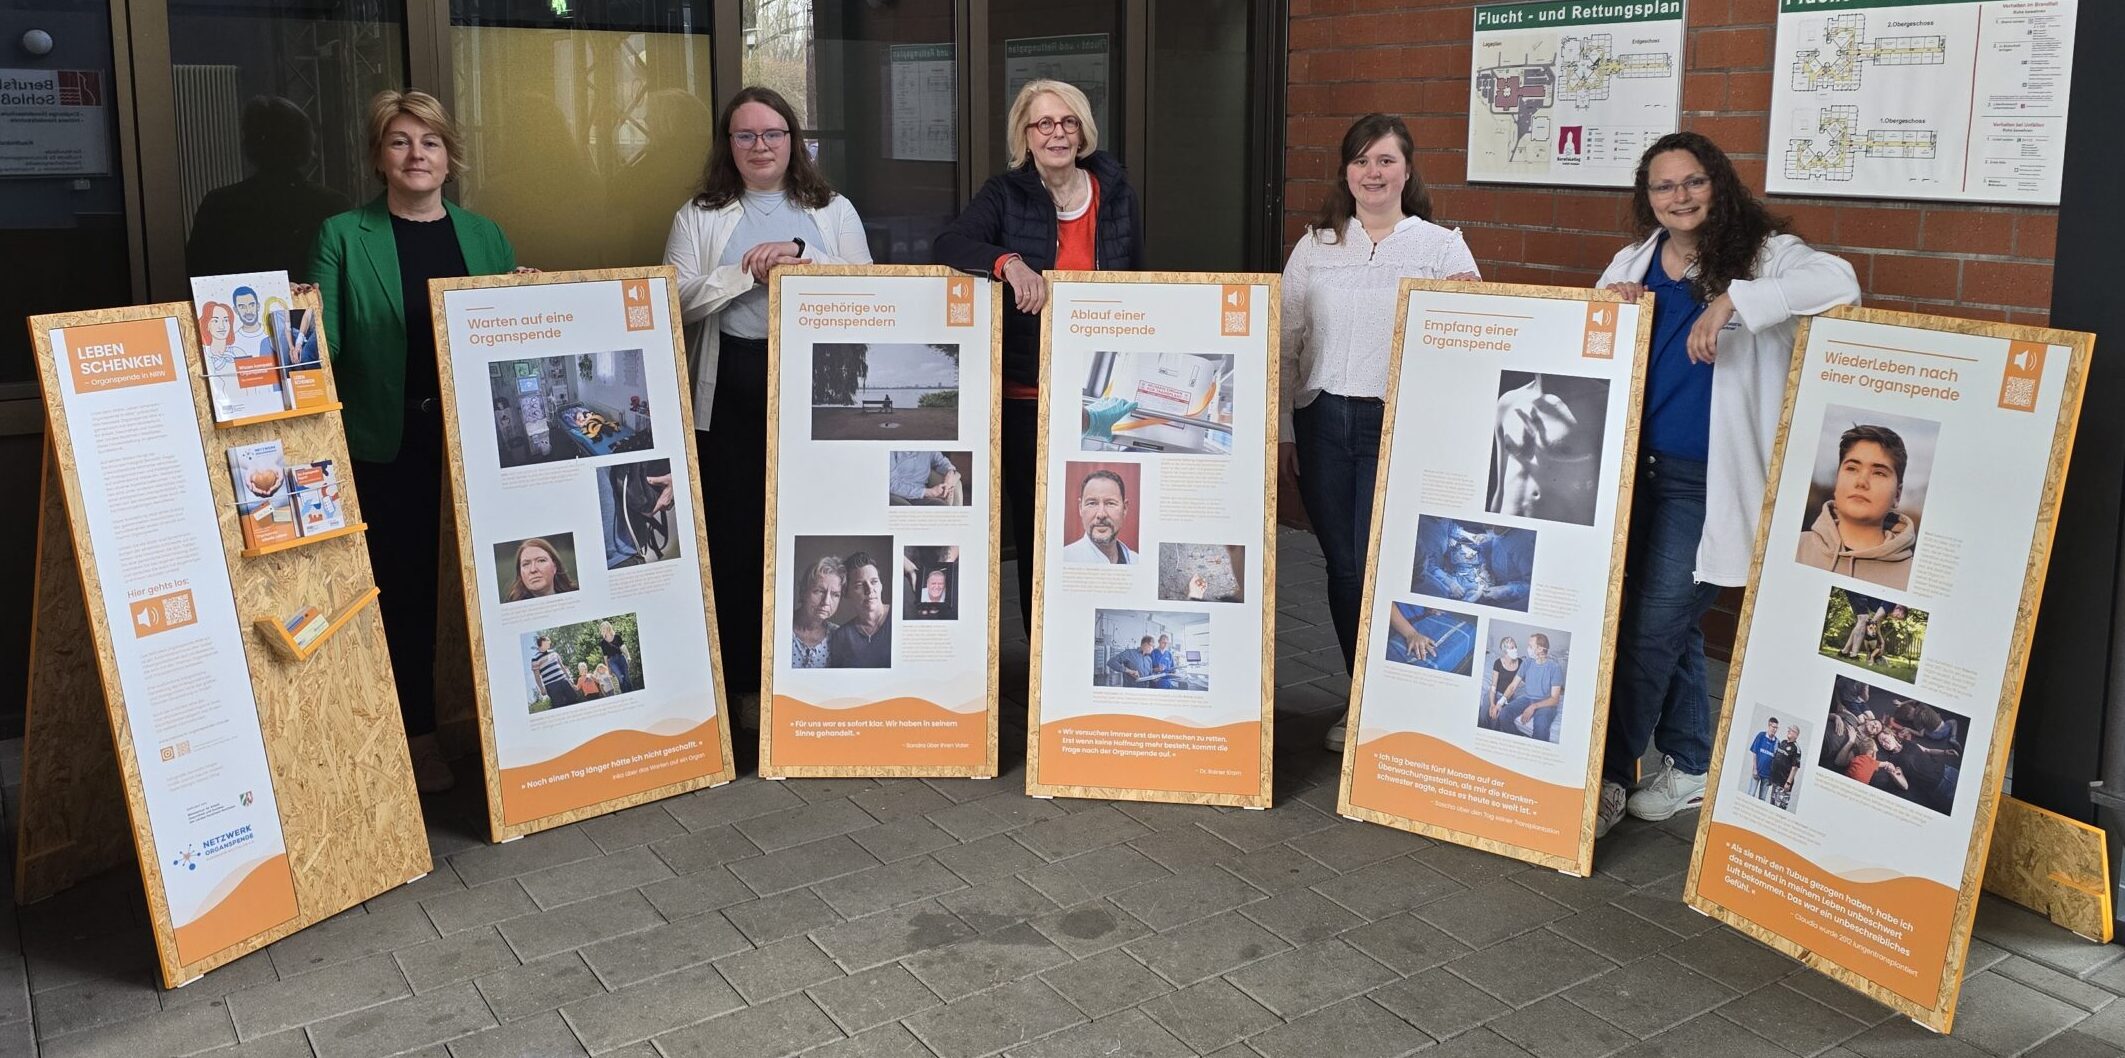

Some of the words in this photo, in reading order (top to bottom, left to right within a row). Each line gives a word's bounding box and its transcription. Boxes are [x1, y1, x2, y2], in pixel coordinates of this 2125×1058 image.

[1478, 10, 1523, 25] Flucht
[1539, 6, 1566, 20] und
[1572, 0, 1680, 19] Rettungsplan
[799, 302, 870, 316] Angehörige
[874, 304, 896, 313] von
[1070, 309, 1111, 320] Ablauf
[1114, 310, 1145, 321] einer
[468, 317, 518, 329] Warten
[521, 313, 542, 325] auf
[546, 312, 574, 323] eine
[799, 316, 896, 330] Organspendern
[1424, 320, 1482, 337] Empfang
[1486, 324, 1518, 336] einer
[470, 328, 561, 346] Organspende
[1070, 324, 1155, 337] Organspende
[77, 343, 124, 360] LEBEN
[1423, 335, 1511, 352] Organspende
[80, 354, 163, 375] SCHENKEN
[1825, 351, 1915, 376] WiederLeben
[1919, 367, 1959, 382] nach
[91, 374, 141, 386] Organspende
[149, 370, 166, 378] NRW
[1821, 369, 1855, 384] einer
[1858, 375, 1960, 401] Organspende
[127, 589, 146, 598] Hier
[148, 582, 173, 595] gehts
[816, 729, 855, 738] gehandelt.
[1062, 746, 1080, 754] Frage
[1112, 749, 1157, 757] Organspende
[1113, 740, 1143, 748] Hoffnung
[527, 778, 547, 788] Noch
[548, 773, 570, 783] einen
[571, 769, 585, 777] Tag
[586, 762, 610, 774] länger
[611, 757, 630, 768] hätte
[631, 754, 643, 763] ich
[644, 750, 662, 759] nicht
[663, 741, 698, 756] geschafft.
[1379, 753, 1390, 761] Ich
[1391, 755, 1404, 765] lag
[1405, 758, 1430, 770] bereits
[1431, 764, 1446, 773] fünf
[1447, 768, 1475, 780] Monate
[1477, 776, 1490, 784] auf
[1491, 778, 1505, 787] der
[1377, 773, 1413, 787] schwester
[1414, 782, 1437, 793] sagte,
[1438, 787, 1456, 797] dass
[1468, 794, 1490, 805] heute
[1502, 803, 1518, 812] weit
[1461, 782, 1472, 790] als
[1488, 788, 1500, 797] die
[1501, 791, 1538, 805] Kranken-
[203, 824, 252, 848] NETZWERK
[205, 832, 254, 856] ORGANSPENDE
[1725, 875, 1750, 893] Gefühl.
[1731, 843, 1743, 854] Als
[1743, 849, 1754, 858] sie
[1755, 854, 1769, 865] mir
[1769, 861, 1785, 872] den
[1786, 867, 1809, 884] Tubus
[1810, 880, 1844, 900] gezogen
[1845, 894, 1874, 915] haben,
[1876, 908, 1899, 925] habe
[1900, 919, 1914, 932] ich
[1729, 854, 1742, 865] das
[1744, 861, 1762, 874] erste
[1764, 870, 1778, 881] Mal
[1779, 876, 1786, 886] in
[1787, 882, 1820, 901] meinem
[1822, 897, 1846, 914] Leben
[1847, 909, 1902, 940] unbeschwert
[1726, 864, 1740, 876] Luft
[1742, 871, 1785, 898] bekommen.
[1787, 892, 1802, 905] Das
[1804, 901, 1819, 913] war
[1820, 908, 1833, 920] ein
[1834, 915, 1910, 956] unbeschreibliches
[1795, 913, 1818, 929] Claudia
[1853, 941, 1919, 977] lungentransplantiert
